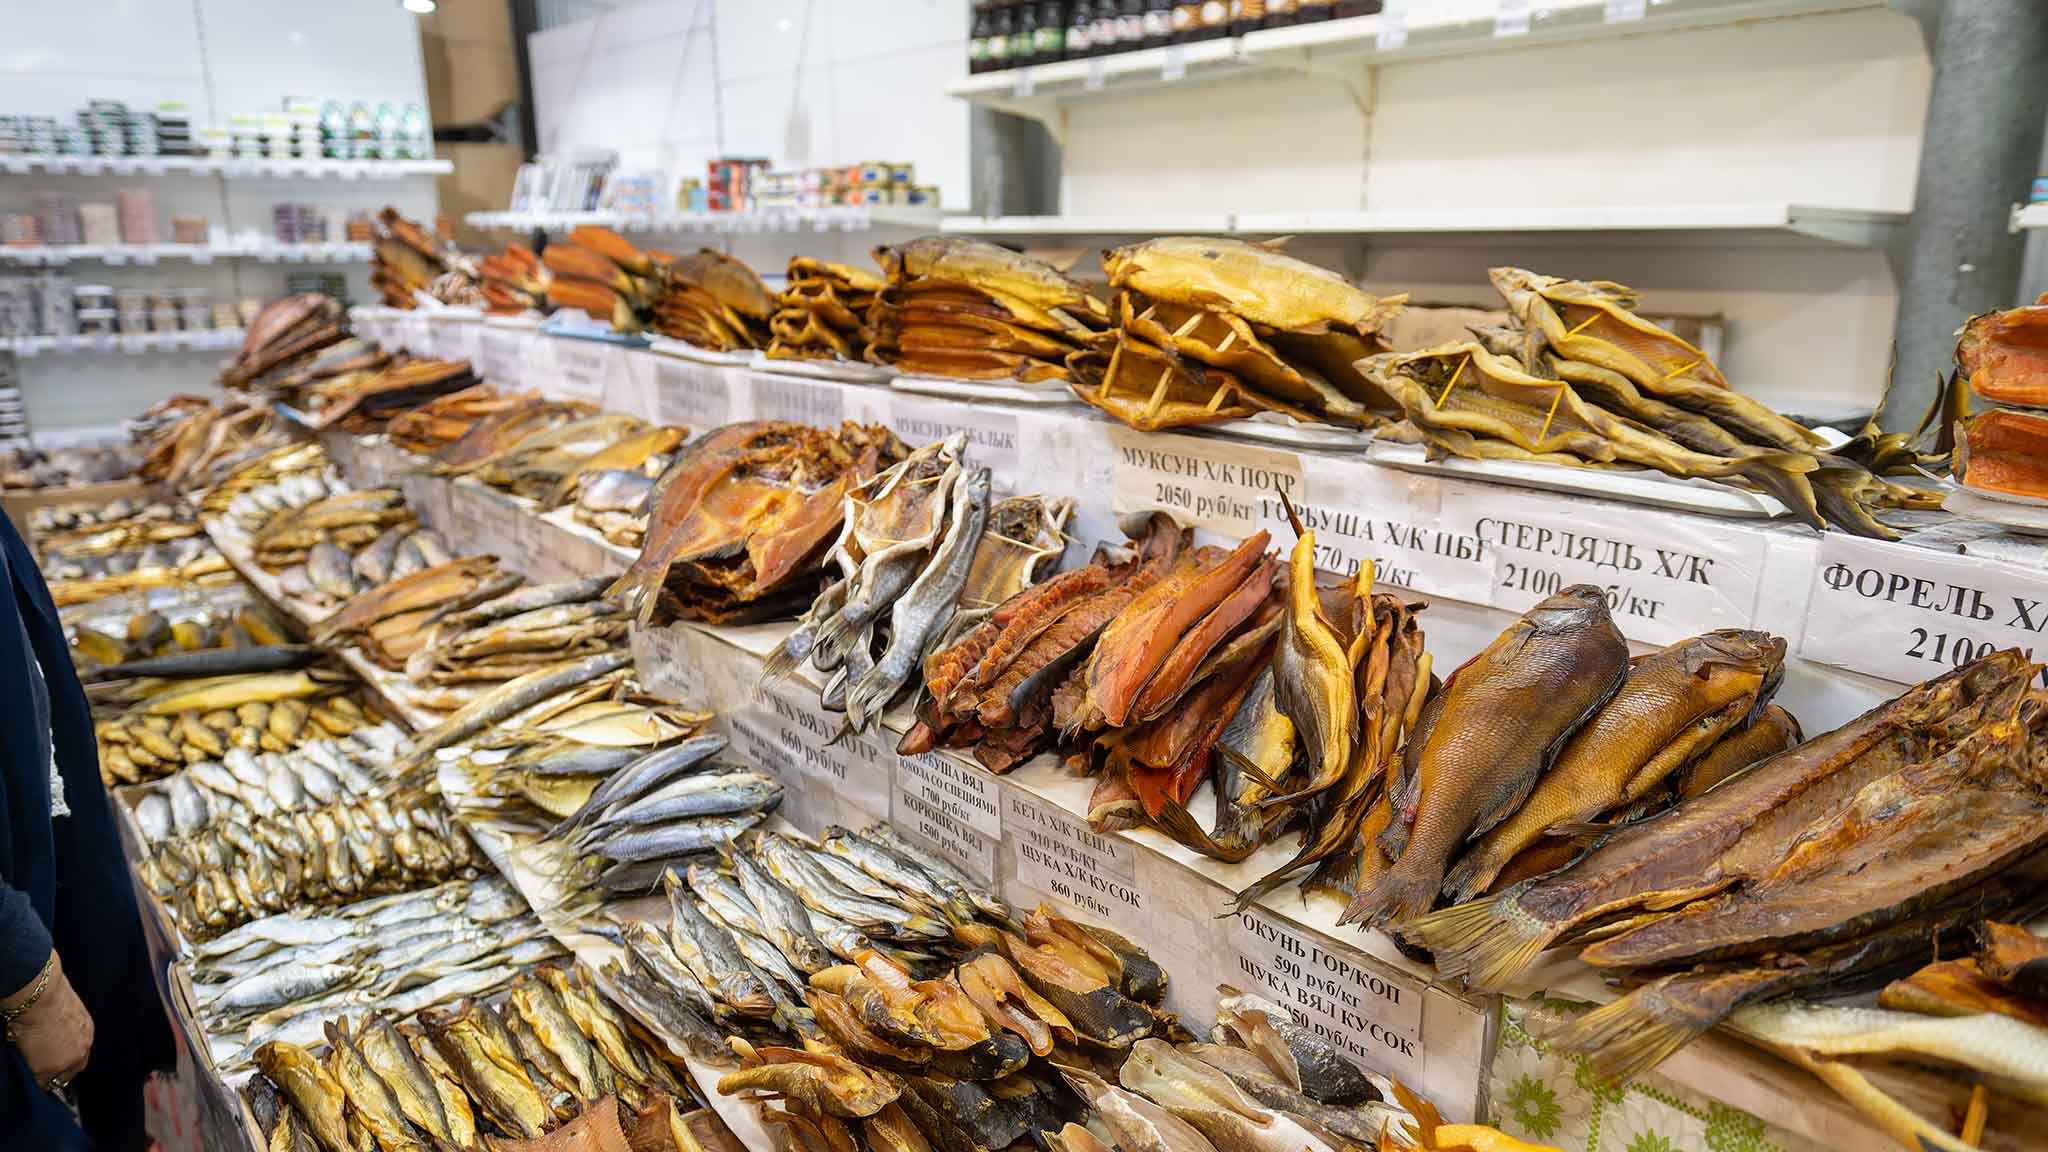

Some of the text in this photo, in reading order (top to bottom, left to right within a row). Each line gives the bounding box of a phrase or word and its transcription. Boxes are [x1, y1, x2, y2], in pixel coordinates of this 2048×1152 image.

[1122, 447, 1296, 494] МУКСУН Х/К ПОТР
[1156, 483, 1254, 520] 2050 руб/кг
[1383, 520, 1428, 552] Х/К
[1475, 517, 1715, 585] СТЕРЛЯДЬ Х/К
[1346, 557, 1419, 588] рб/кг
[1501, 563, 1561, 595] 2100
[1823, 562, 1995, 621] ФОРЕЛЬ
[914, 751, 985, 794] ОРБУША ВЯЛ
[922, 785, 940, 806] 1700
[931, 775, 943, 790] СО
[944, 781, 997, 817] СПЕЦИЯМИ
[903, 794, 984, 853] КОРЮШКА ВЯЛ
[919, 821, 939, 841] 1500
[1012, 799, 1046, 825] КЕТА
[1049, 816, 1072, 837] Х/К
[1030, 830, 1098, 872] 910 РУБ/КГ
[1021, 843, 1142, 909] ЩУКА Х/К КУСОК
[1050, 879, 1112, 918] 860 руб/кг
[1243, 913, 1401, 1006] ОКУНЬ ГОР/КОП
[1273, 954, 1362, 1009] 590 руб/кг
[1239, 955, 1416, 1058] ЩУКА ВЯЛ КУСОК
[1276, 998, 1309, 1028] 50
